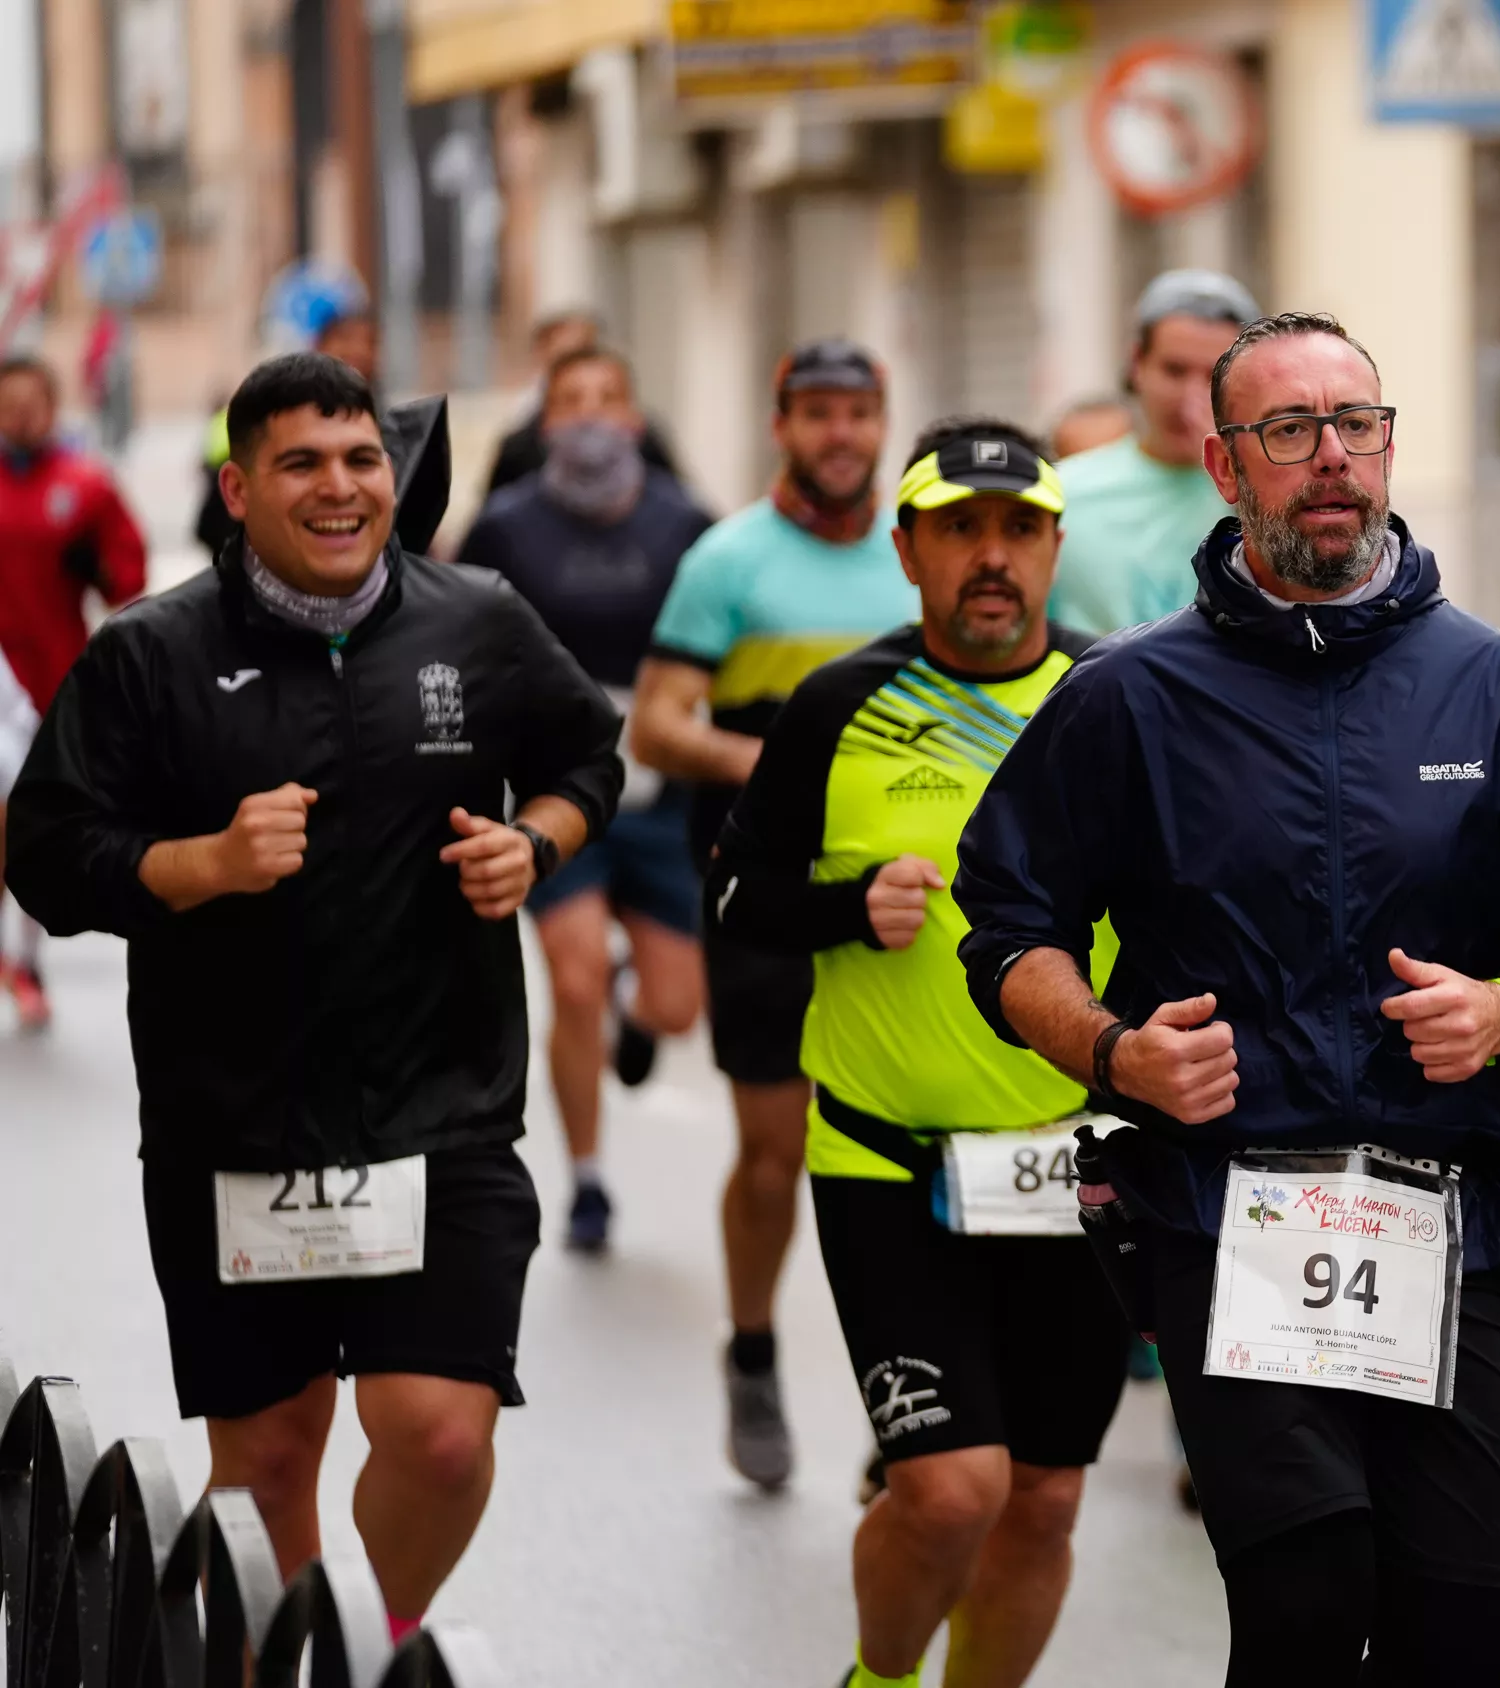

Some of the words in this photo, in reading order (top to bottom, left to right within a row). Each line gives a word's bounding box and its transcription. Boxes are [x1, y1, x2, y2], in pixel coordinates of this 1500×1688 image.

[1419, 764, 1462, 774] REGATTA
[1420, 773, 1442, 781] GREAT
[1443, 771, 1485, 780] OUTDOORS
[267, 1165, 371, 1212] 212
[1352, 1195, 1401, 1219] MARATÓN
[1319, 1209, 1389, 1239] LUCENA
[1303, 1253, 1380, 1315] 94
[1270, 1323, 1292, 1333] JUAN
[1294, 1325, 1332, 1336] ANTONIO
[1333, 1329, 1375, 1342] BUJALANCE
[1376, 1332, 1397, 1345] LÓPEZ
[1315, 1339, 1358, 1351] XL-Hombre
[1363, 1367, 1428, 1384] mediamaratonlucena.com
